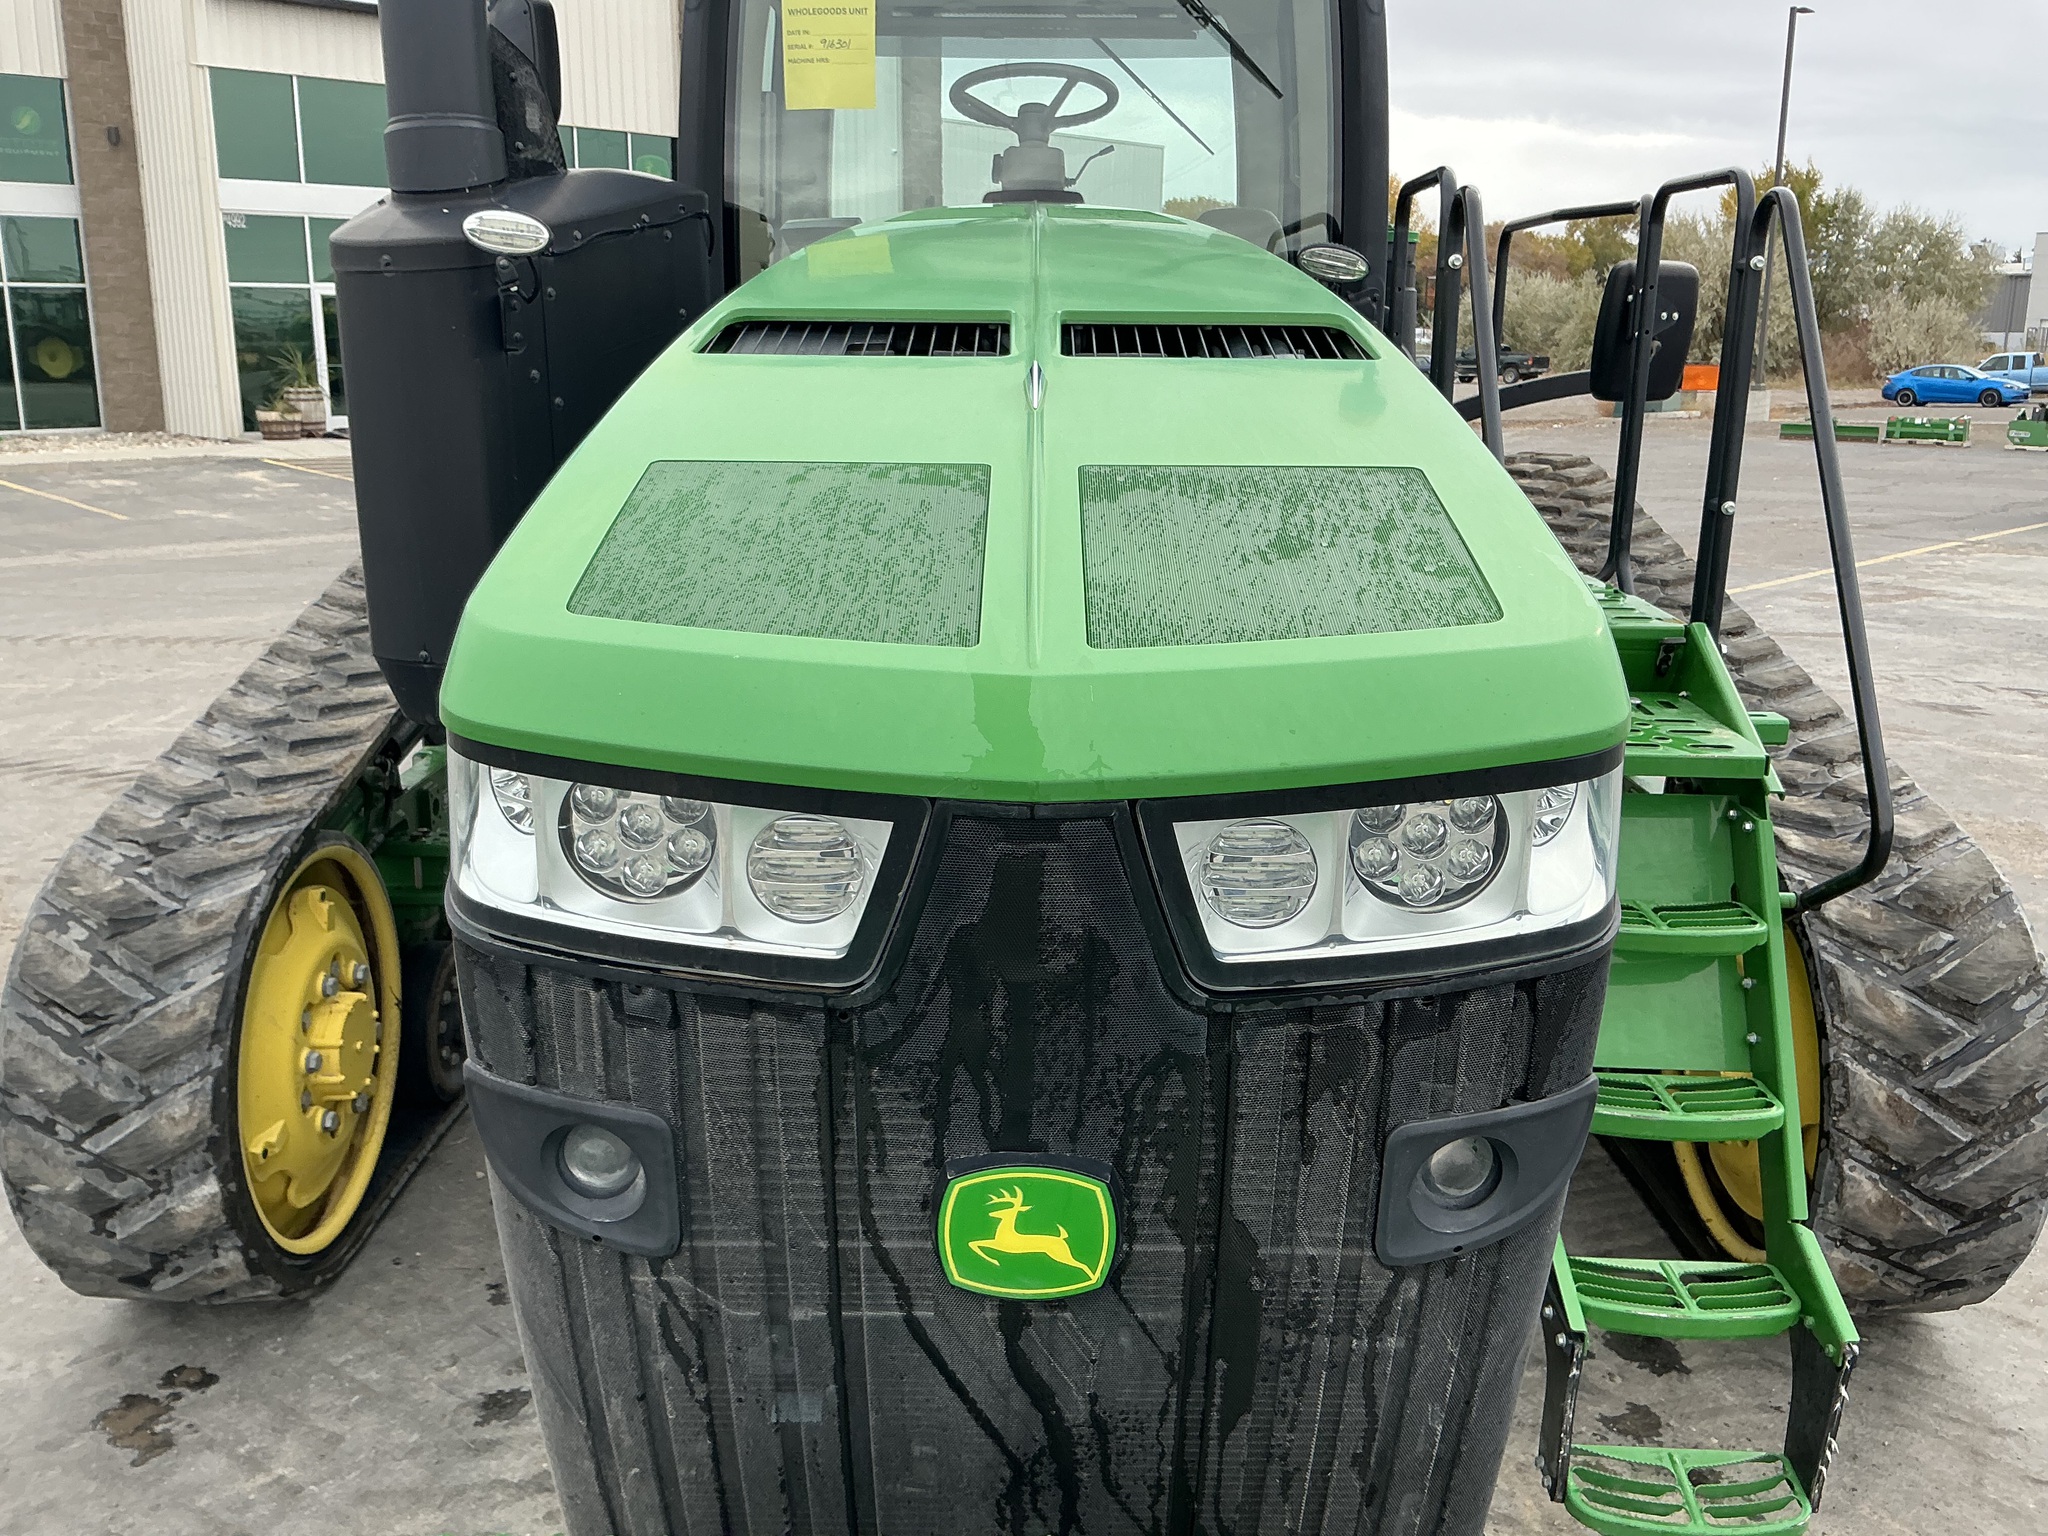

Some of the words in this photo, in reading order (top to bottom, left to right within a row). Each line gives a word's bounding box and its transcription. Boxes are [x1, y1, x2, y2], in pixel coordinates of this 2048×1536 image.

[787, 8, 847, 16] WHOLEGOODS
[849, 7, 869, 15] UNIT
[820, 38, 851, 49] 916301
